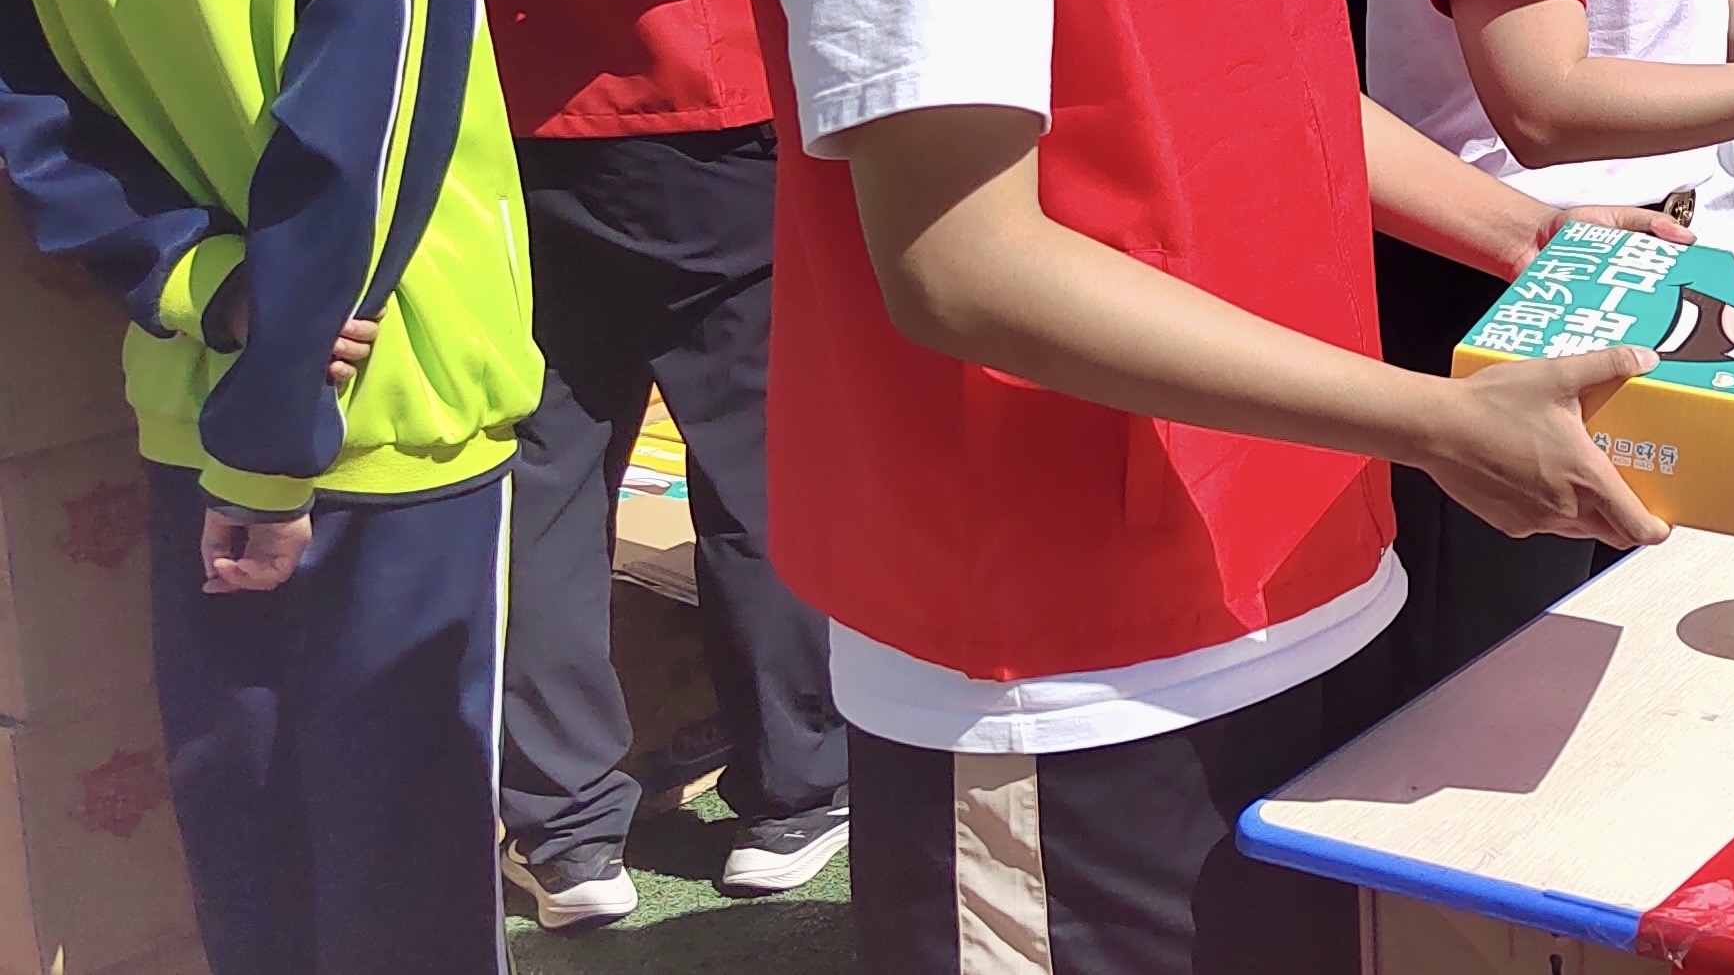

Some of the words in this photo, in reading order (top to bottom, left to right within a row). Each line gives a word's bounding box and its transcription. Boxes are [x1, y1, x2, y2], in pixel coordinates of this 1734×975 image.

[1472, 223, 1623, 352] 帮助乡村儿童
[1542, 231, 1690, 358] 养出一口好牙
